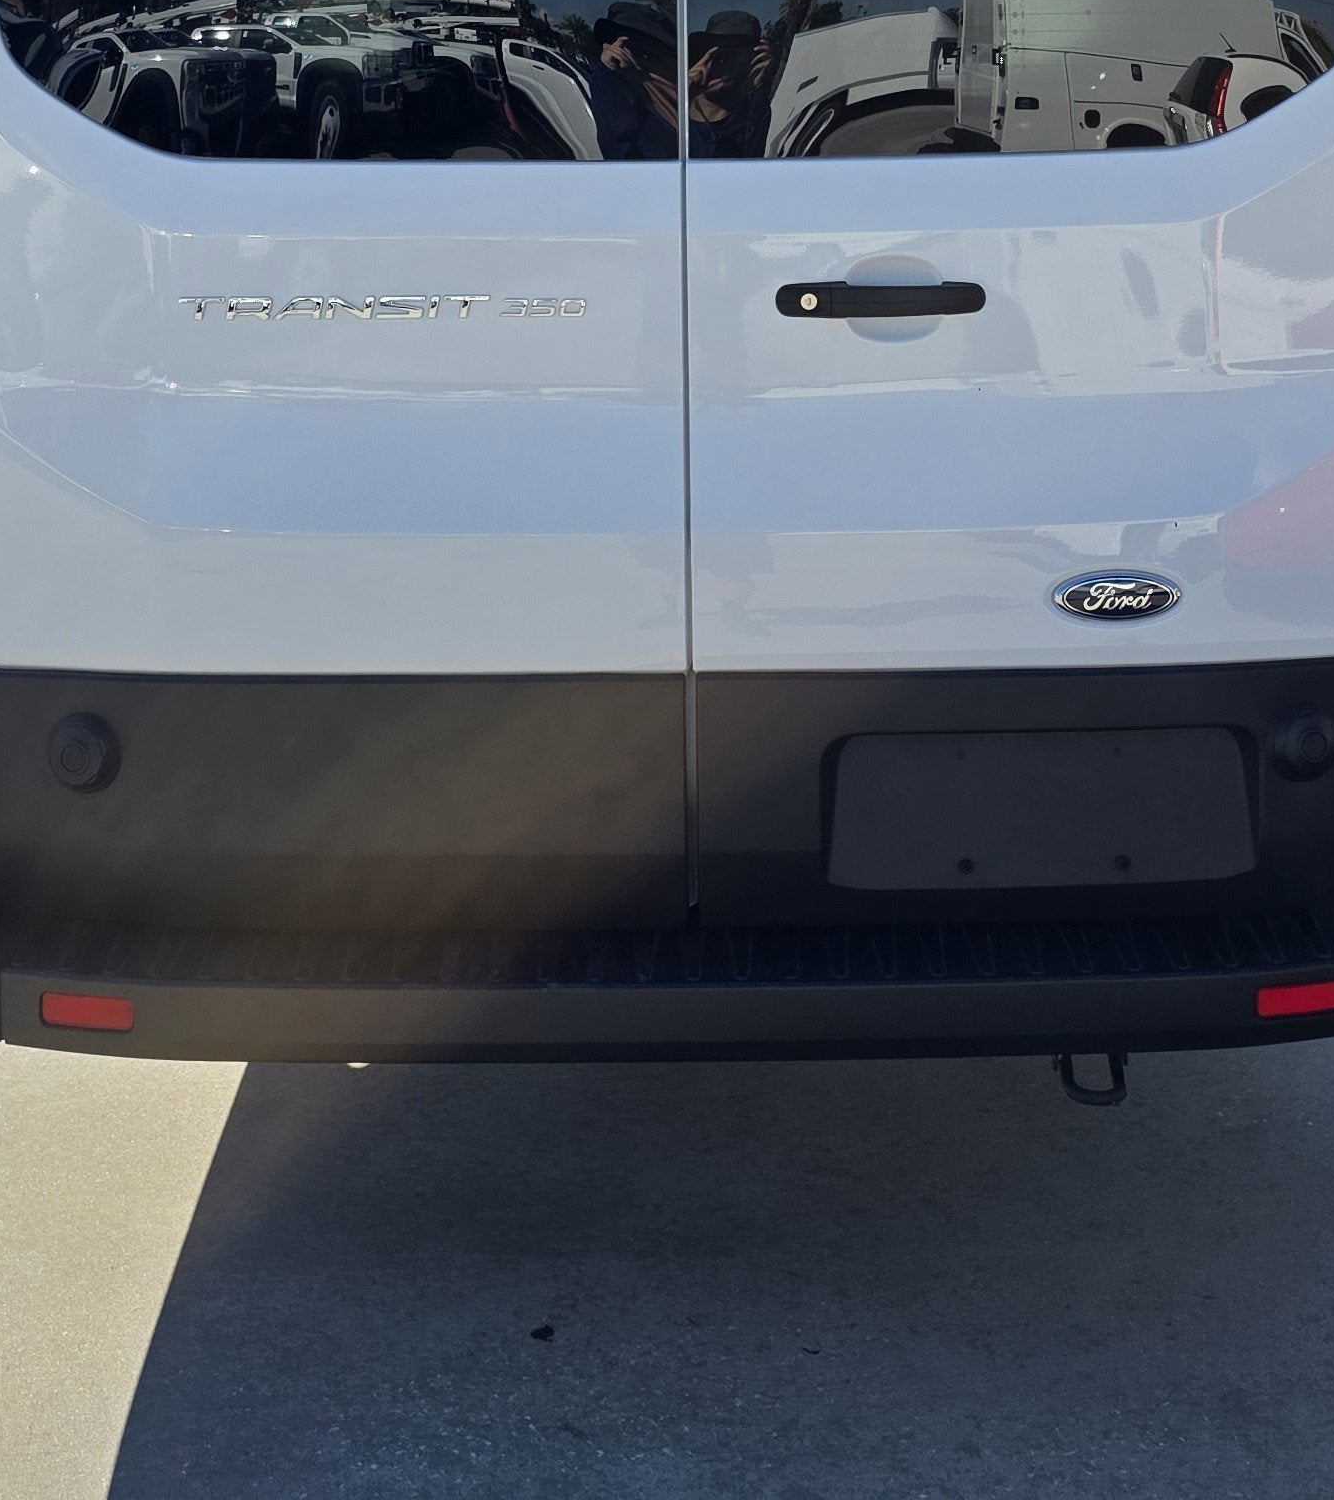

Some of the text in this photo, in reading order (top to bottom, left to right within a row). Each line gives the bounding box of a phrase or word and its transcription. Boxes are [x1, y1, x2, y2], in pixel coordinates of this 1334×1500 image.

[177, 295, 587, 321] TRANSIT 350
[1083, 583, 1154, 611] Ford
